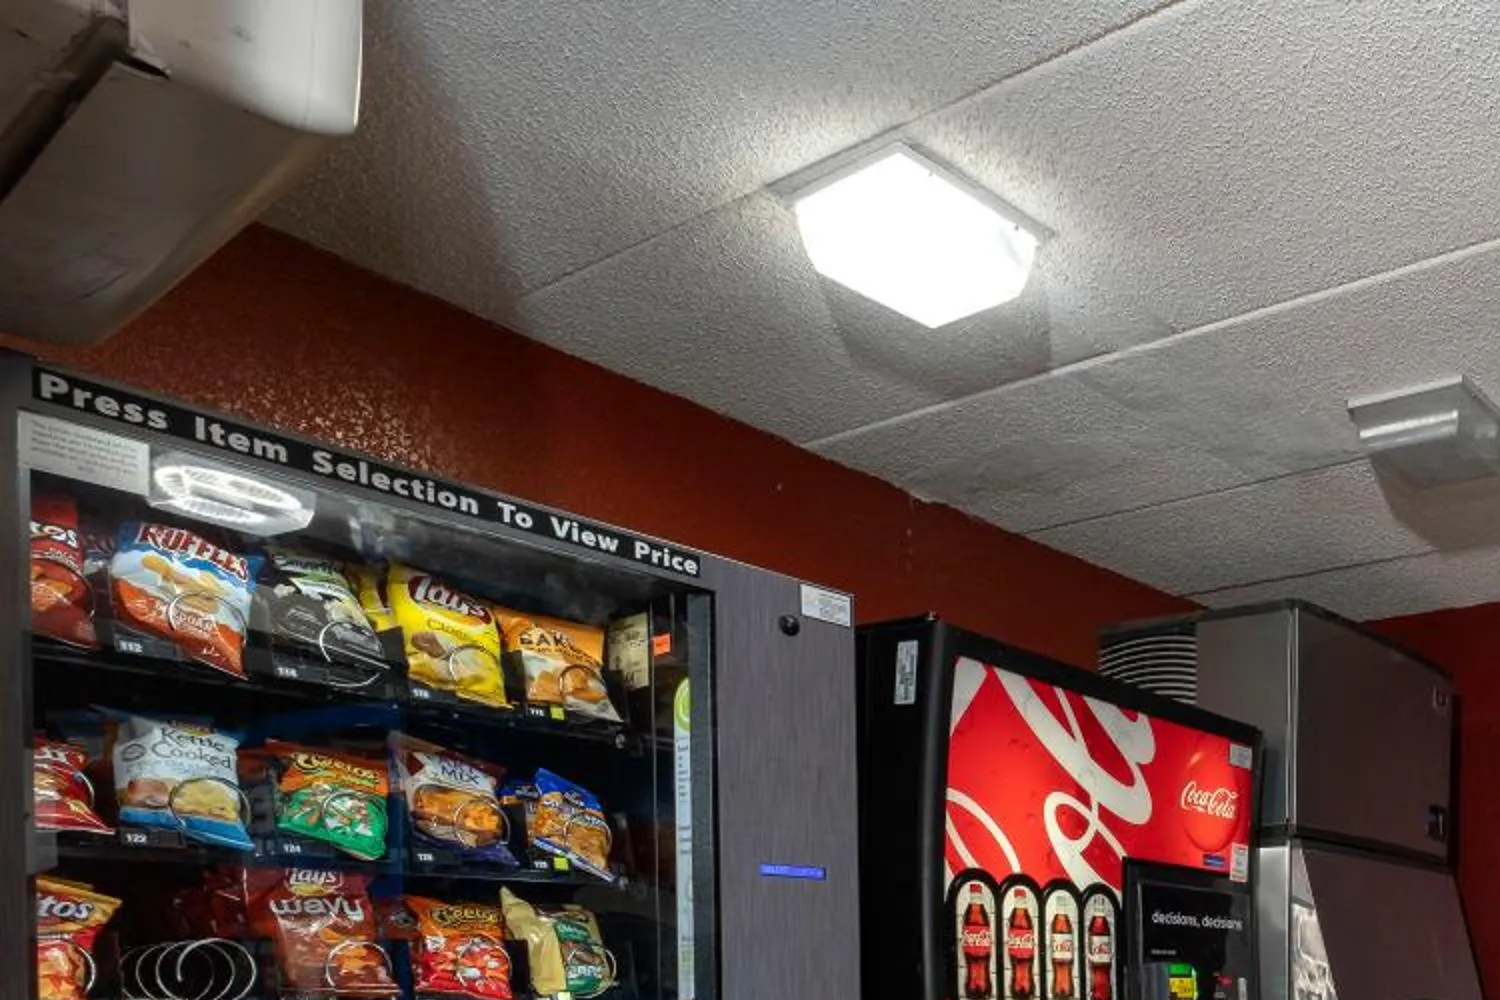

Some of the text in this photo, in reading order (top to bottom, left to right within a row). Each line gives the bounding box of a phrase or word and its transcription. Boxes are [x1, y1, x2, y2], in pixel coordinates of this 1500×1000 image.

[39, 372, 700, 576] Press Item Selection To View Price
[137, 523, 249, 584] RUFFLES
[151, 740, 232, 769] Cooked
[1180, 780, 1240, 820] Coca-Cola
[1152, 911, 1244, 931] decisions, decisions
